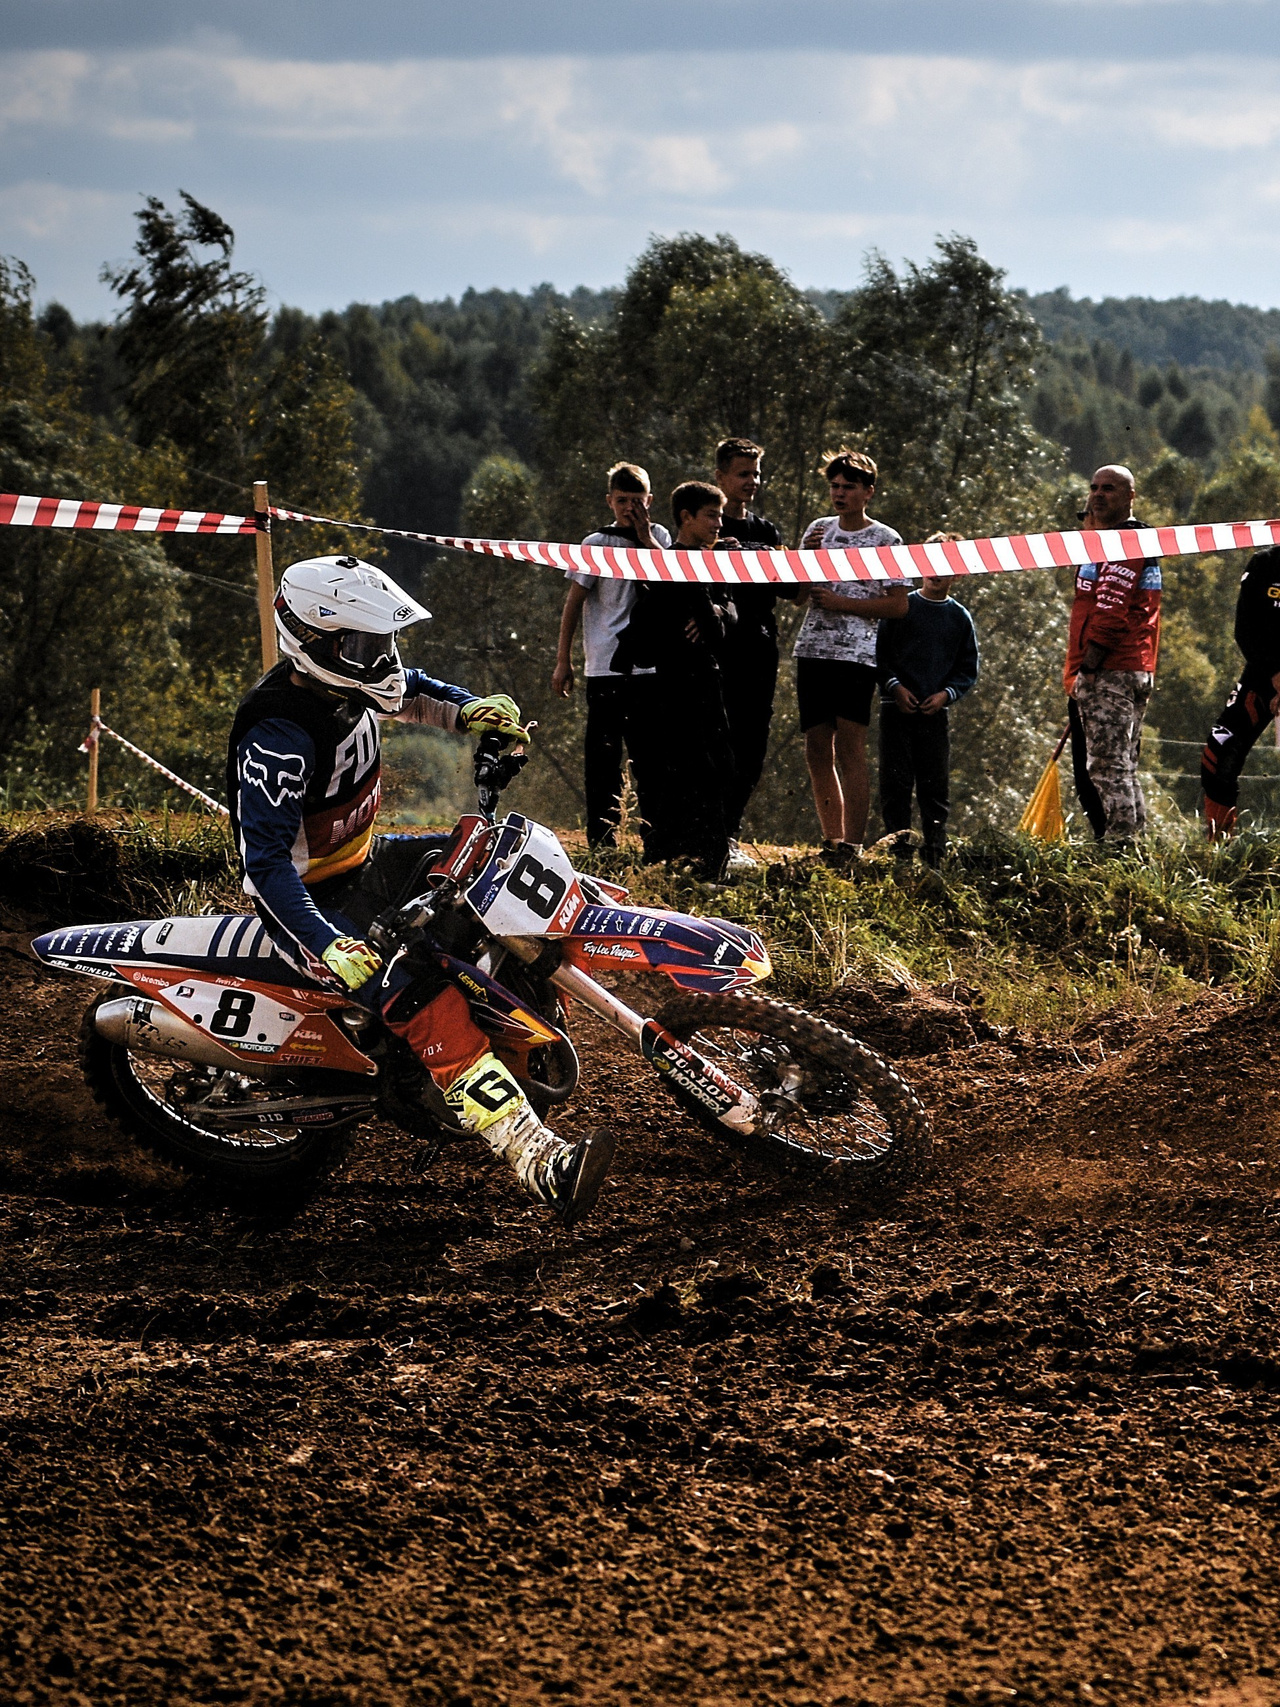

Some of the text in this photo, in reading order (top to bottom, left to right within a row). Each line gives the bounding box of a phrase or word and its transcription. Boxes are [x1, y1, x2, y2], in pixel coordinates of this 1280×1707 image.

[477, 883, 499, 912] GoPro
[506, 854, 567, 920] 8
[558, 893, 581, 930] KTM
[713, 941, 730, 965] KTM
[74, 964, 117, 978] DUNLOP
[141, 972, 170, 987] brembo
[209, 988, 256, 1038] 8
[239, 1042, 275, 1053] MOTOREX
[293, 1030, 323, 1041] KTM
[278, 1053, 324, 1065] SHIFT
[667, 1067, 725, 1114] MOTOREX
